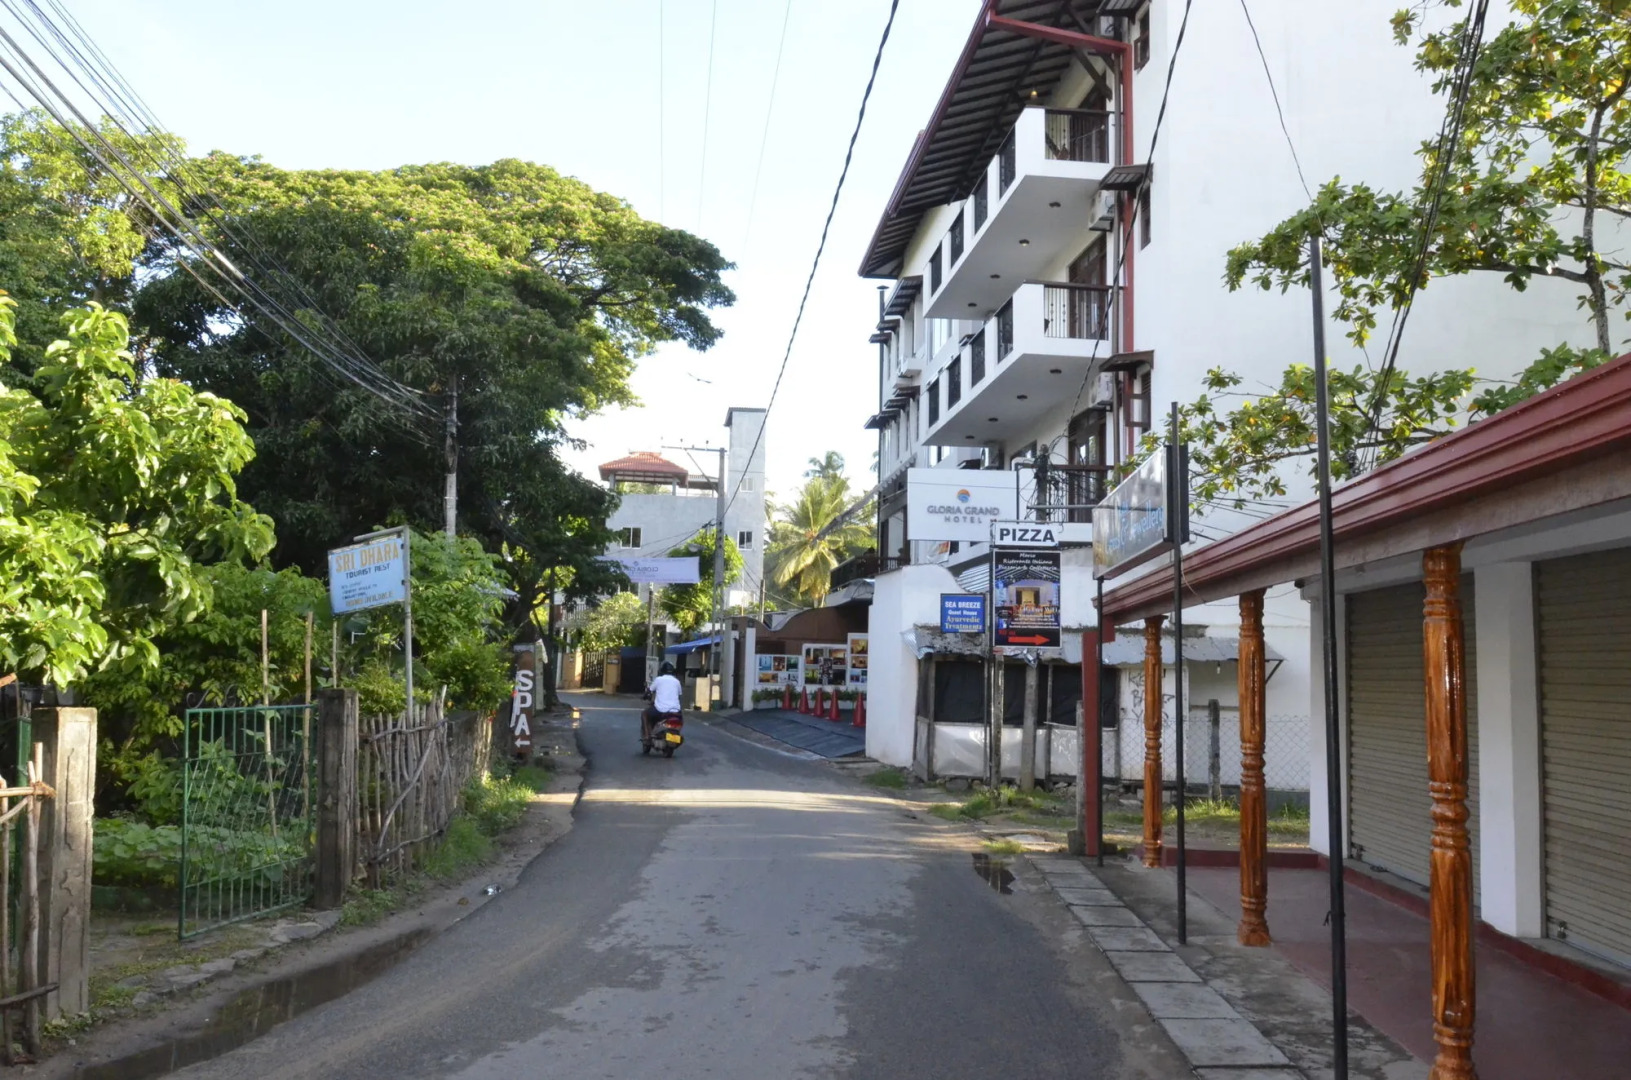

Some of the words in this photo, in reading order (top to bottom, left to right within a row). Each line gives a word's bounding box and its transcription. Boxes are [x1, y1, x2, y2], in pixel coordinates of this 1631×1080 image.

[926, 505, 962, 514] GLORIA
[964, 506, 1000, 516] GRAND
[944, 516, 982, 524] HOTEL
[999, 528, 1056, 543] PIZZA
[335, 552, 355, 574] SRI
[360, 541, 399, 568] DHARA
[345, 565, 372, 580] TOURIST
[958, 601, 981, 609] BREEZE
[946, 615, 980, 623] Ayurvedic
[514, 669, 534, 736] SPA
